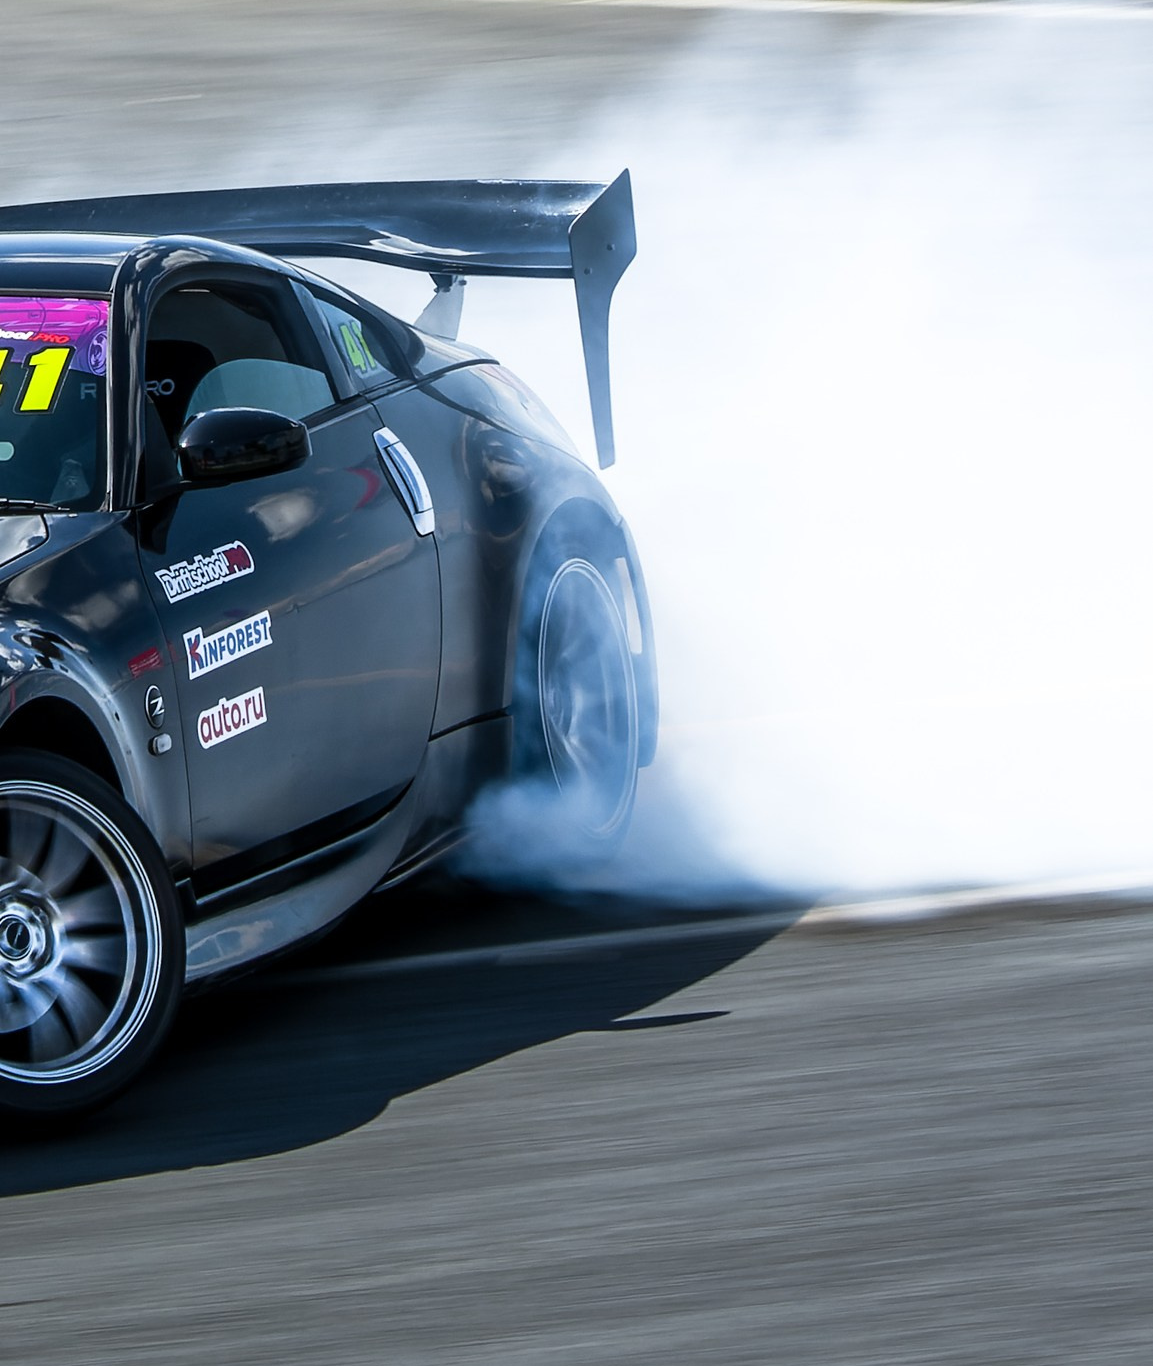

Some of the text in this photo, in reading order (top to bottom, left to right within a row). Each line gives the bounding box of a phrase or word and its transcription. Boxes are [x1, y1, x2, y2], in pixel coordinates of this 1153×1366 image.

[340, 321, 376, 372] 41
[187, 616, 269, 673] KINFOREST
[200, 693, 264, 743] auto.ru
